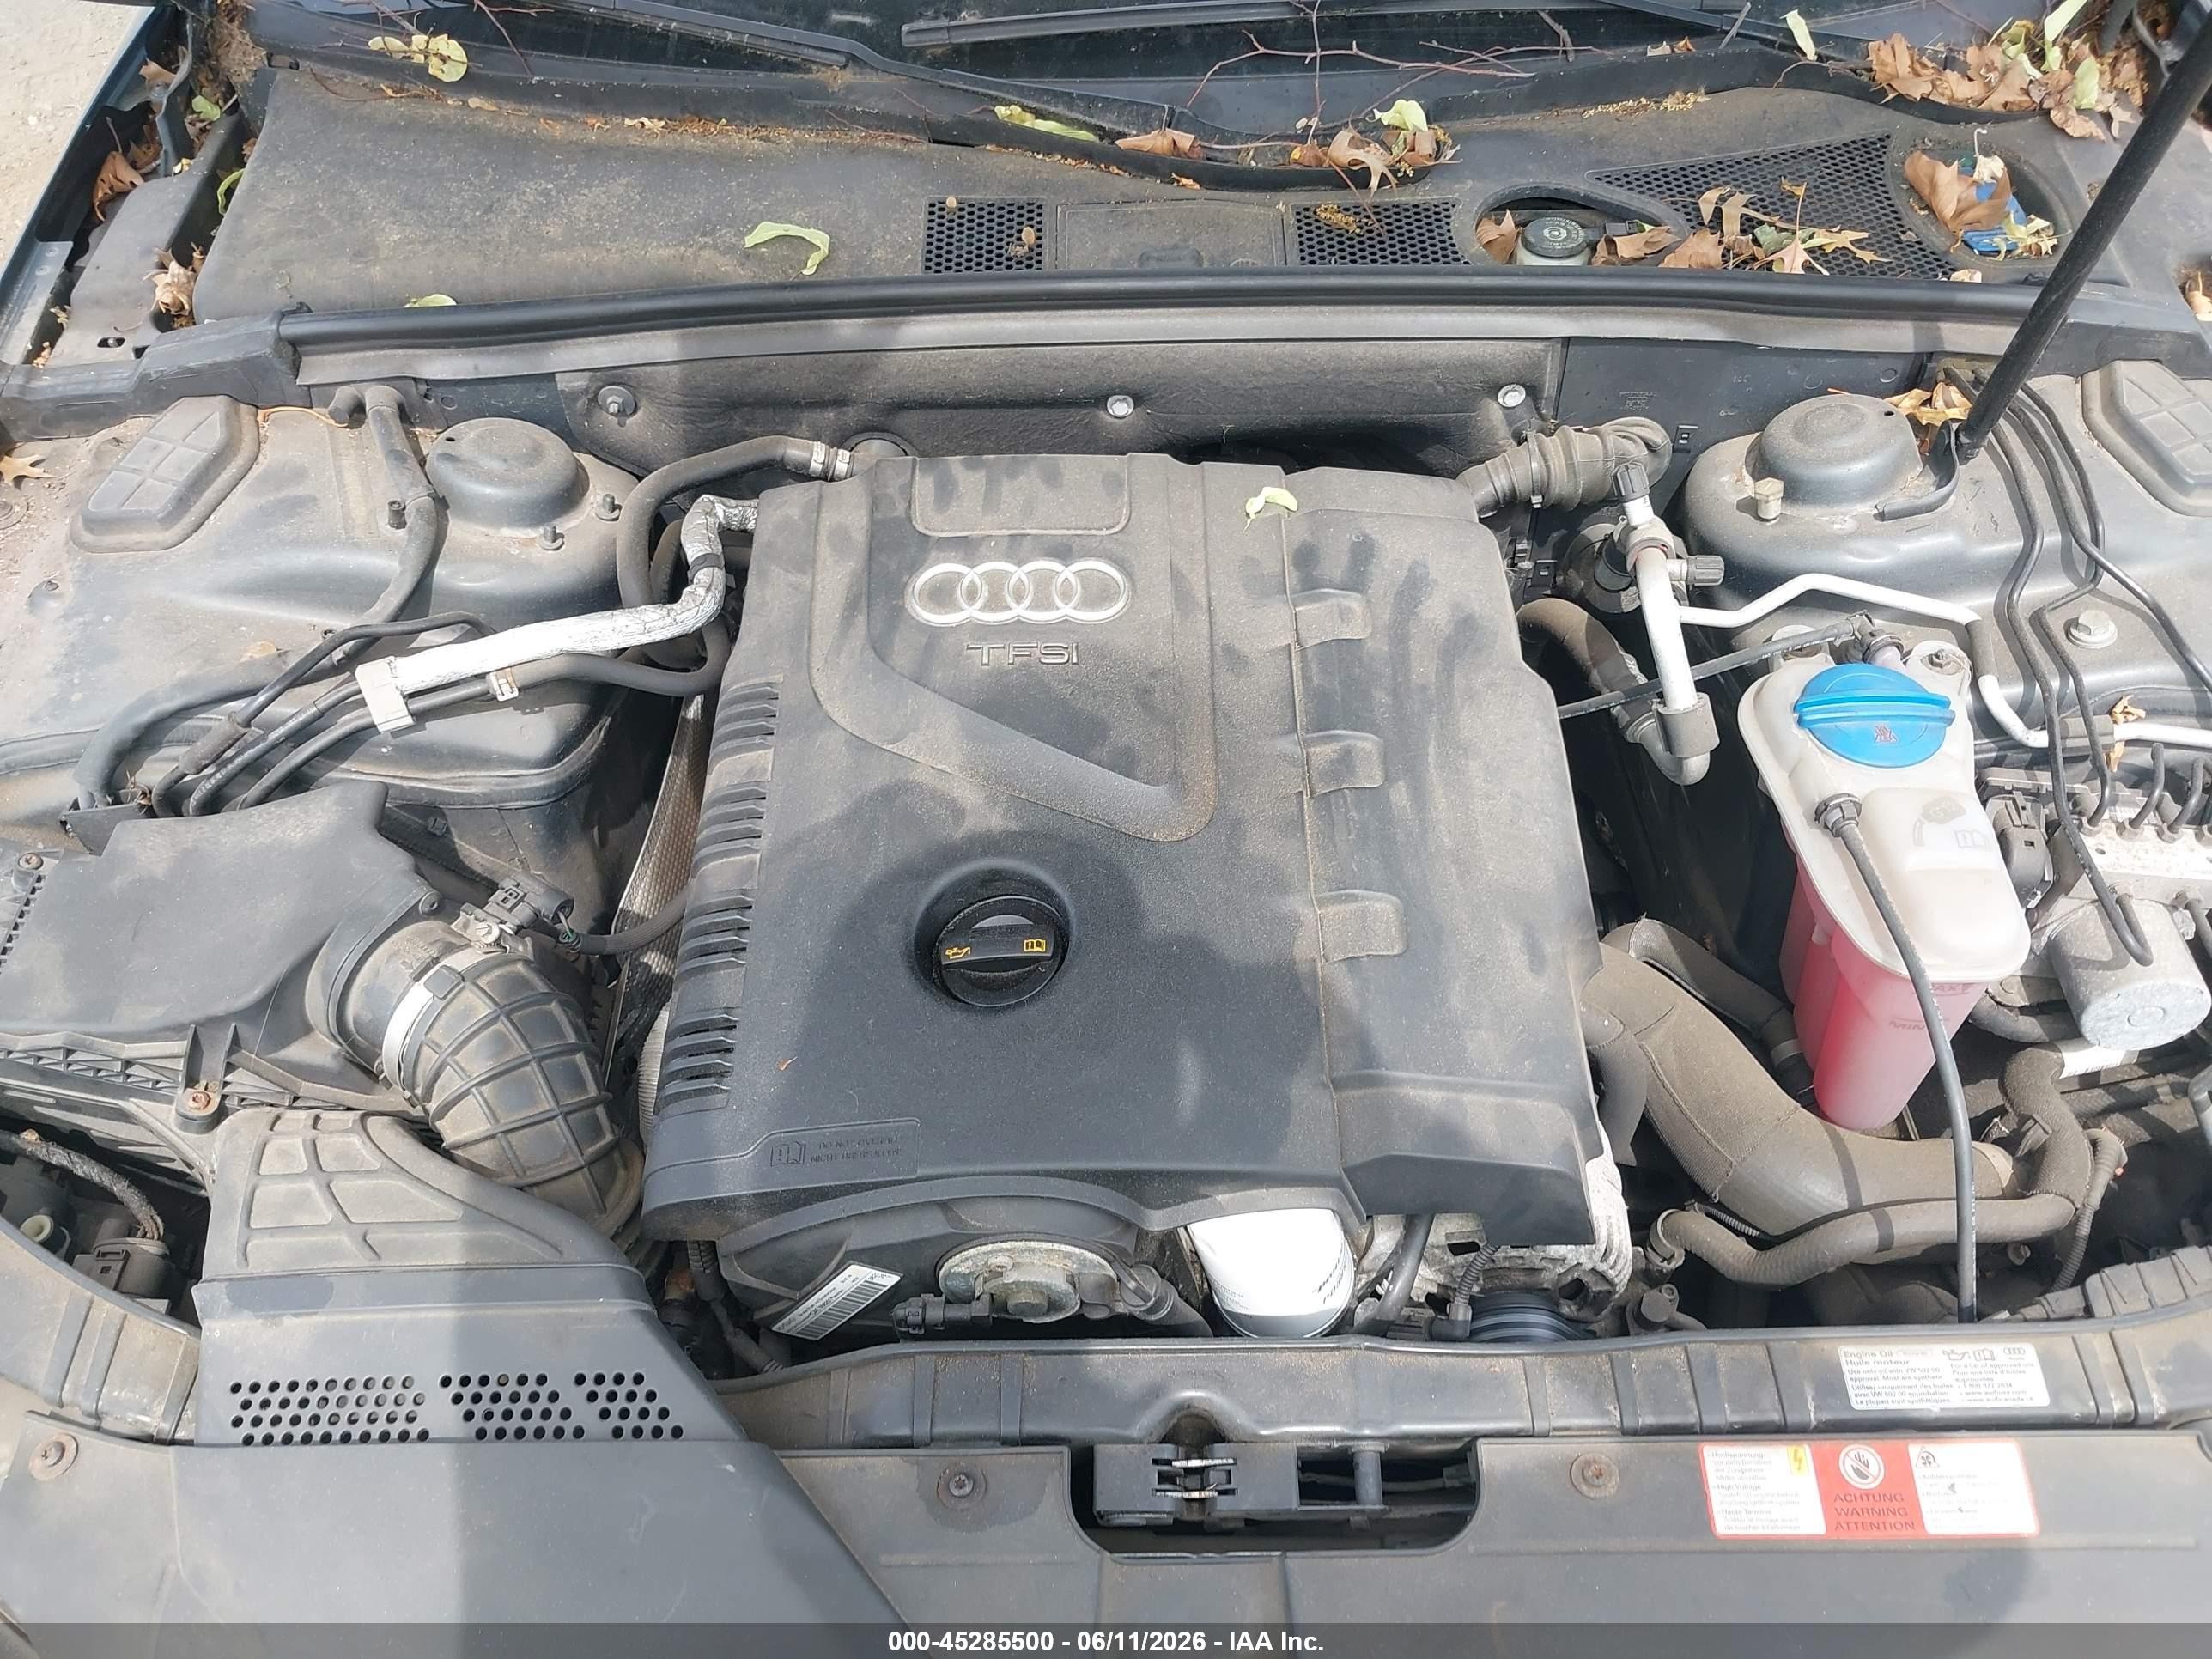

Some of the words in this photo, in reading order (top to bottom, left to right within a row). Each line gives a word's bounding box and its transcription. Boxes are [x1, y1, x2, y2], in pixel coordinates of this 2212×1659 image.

[965, 641, 1079, 666] TFSI
[1843, 1350, 1877, 1359] Engine
[1879, 1349, 1893, 1358] Oil
[1833, 1492, 1905, 1503] ACHTUNG
[1834, 1507, 1908, 1516] WARNING
[1834, 1520, 1916, 1531] ATTENTION
